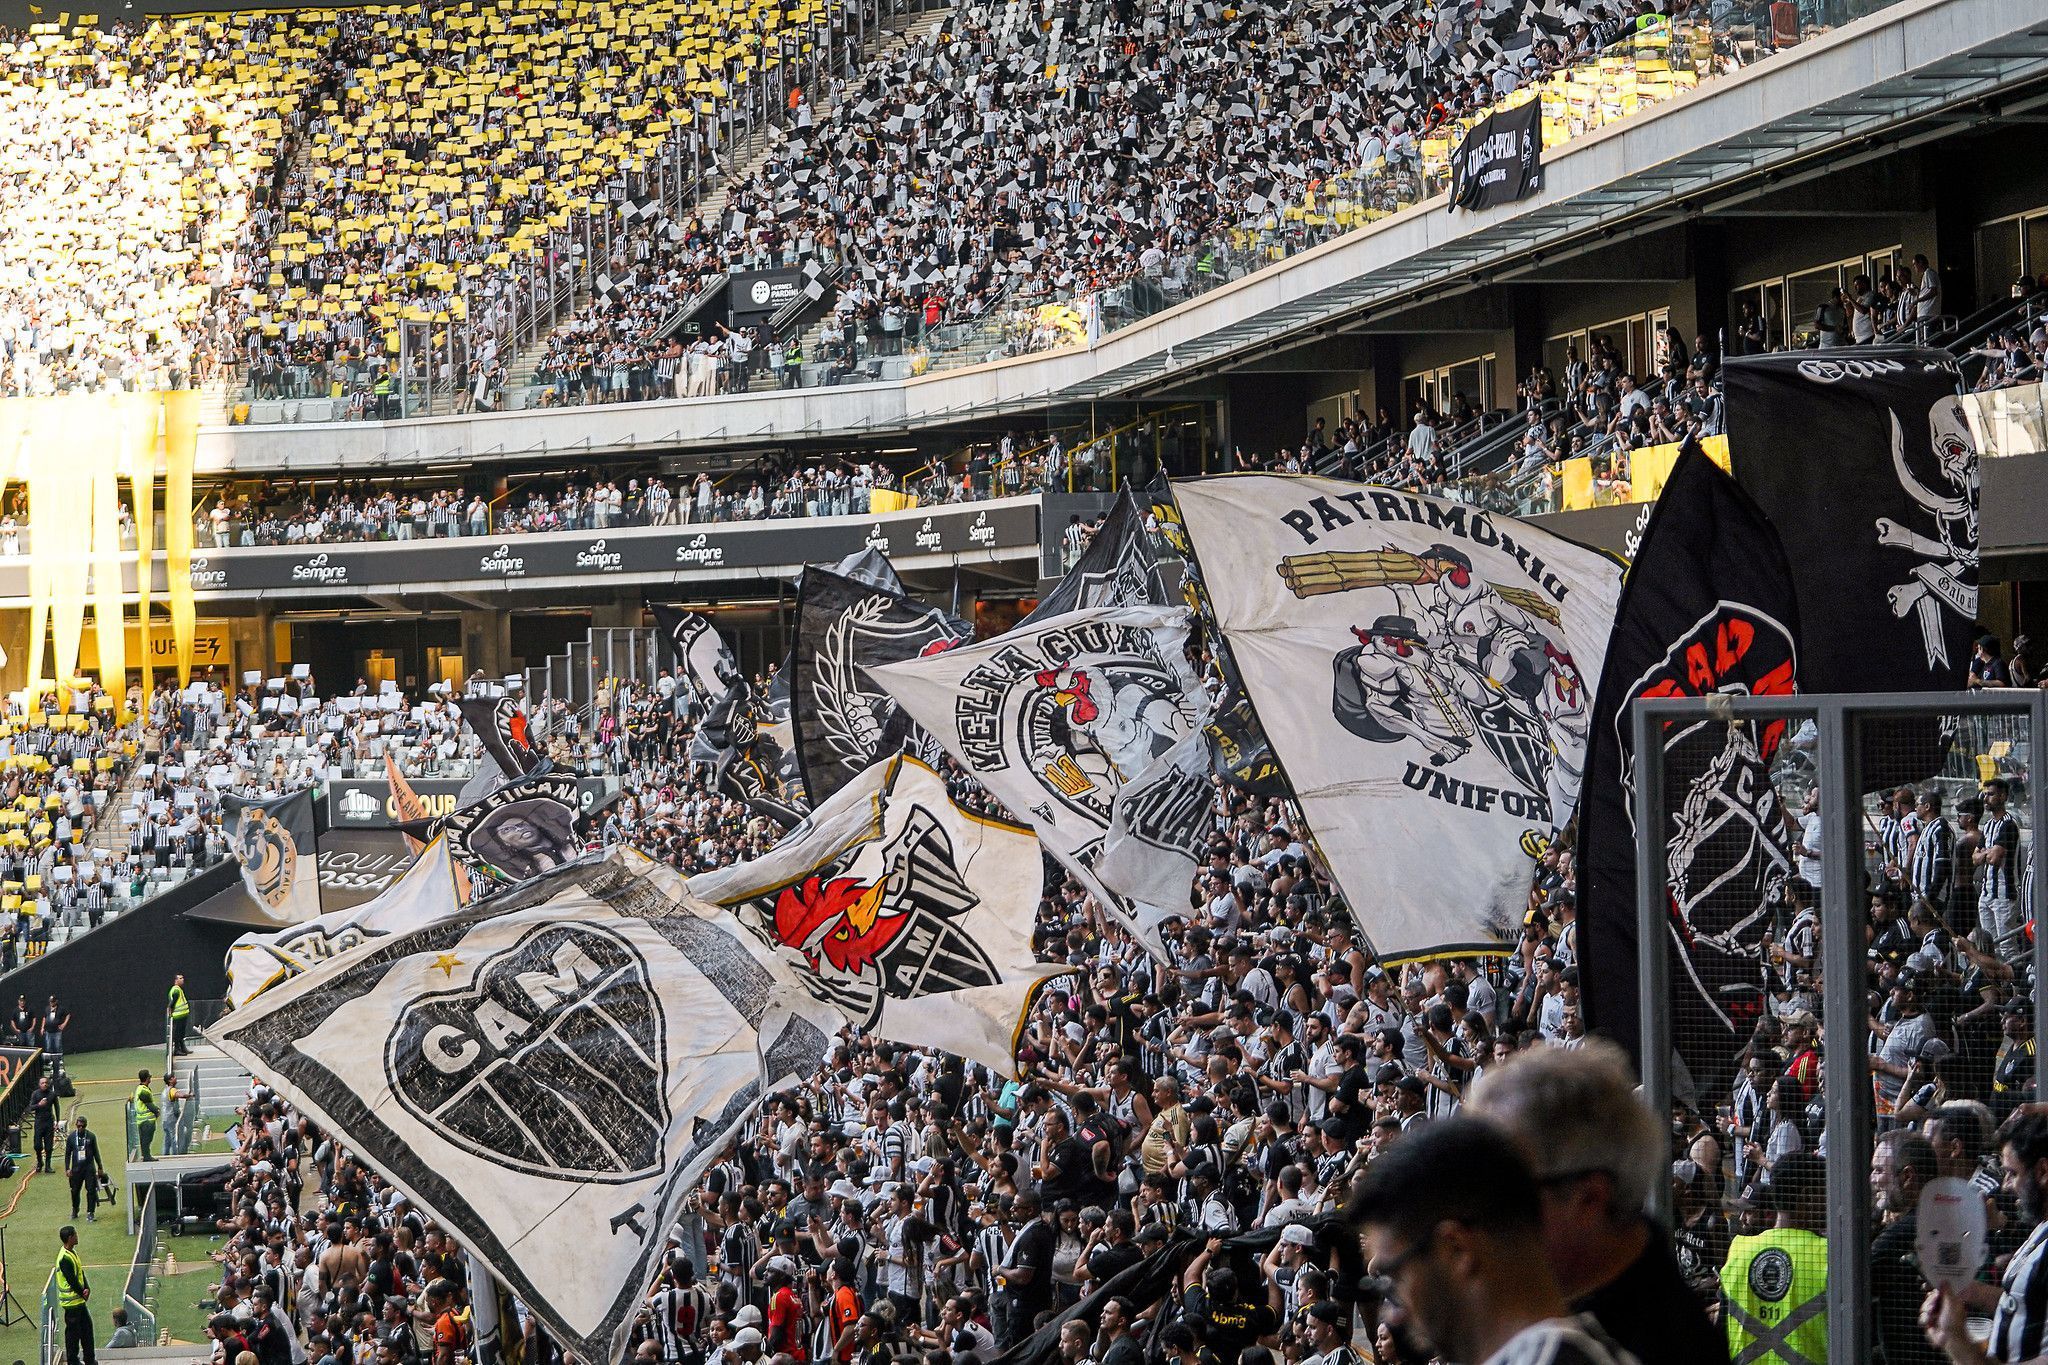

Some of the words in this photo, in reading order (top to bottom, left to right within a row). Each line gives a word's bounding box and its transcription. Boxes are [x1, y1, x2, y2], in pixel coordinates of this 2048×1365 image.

[915, 531, 941, 548] Sempre
[969, 525, 995, 542] Sempre
[676, 546, 723, 562] Sempre
[1281, 491, 1569, 603] PATRIMÔNIO
[481, 557, 523, 573] Sempre
[576, 551, 621, 567] Sempre
[191, 570, 226, 585] mpre
[292, 565, 346, 581] Sempre
[1938, 577, 1965, 606] Galo
[1140, 675, 1167, 690] DO
[1481, 711, 1544, 742] CAM
[1402, 761, 1552, 822] UNIFOR
[319, 870, 395, 890] OSSA
[422, 939, 606, 1074] CAM
[1219, 1312, 1247, 1329] bmg
[1759, 1305, 1781, 1320] 611
[676, 1305, 696, 1338] 9
